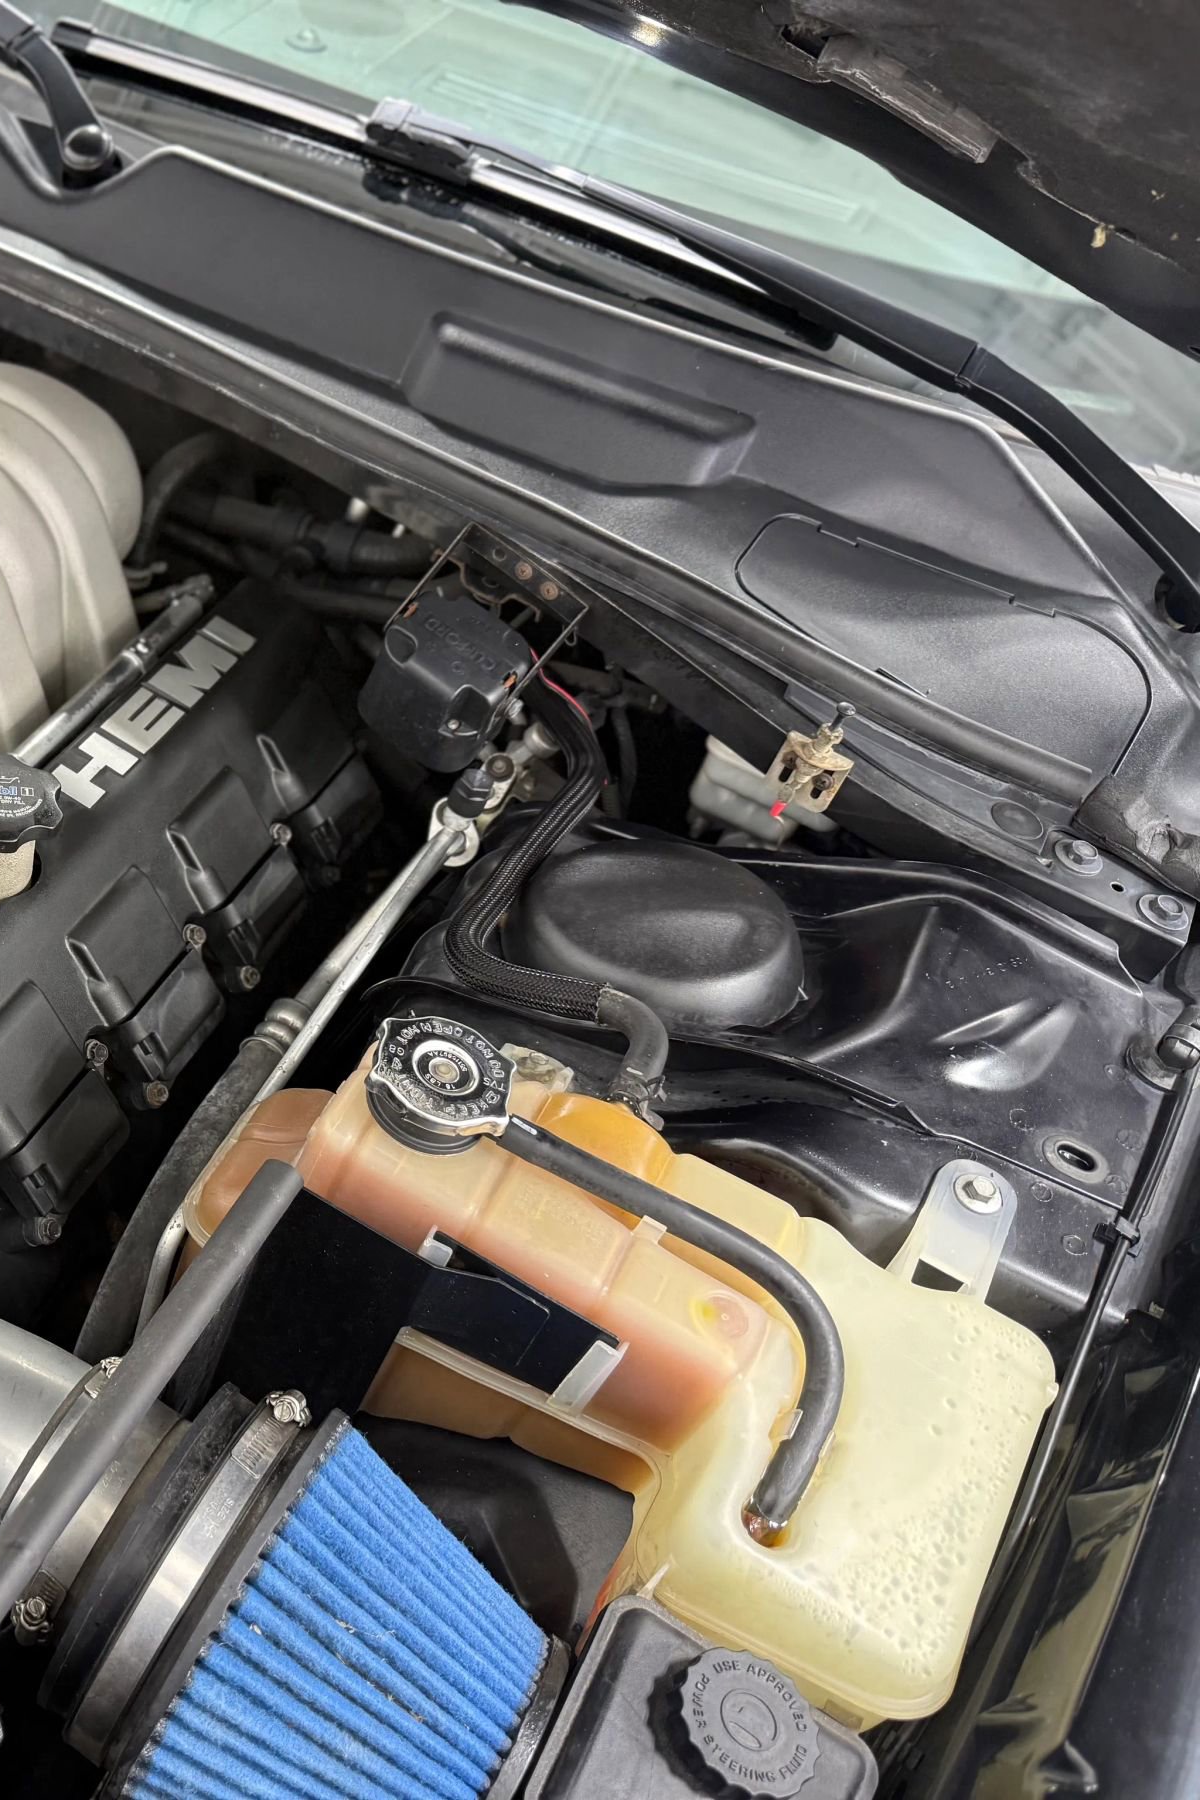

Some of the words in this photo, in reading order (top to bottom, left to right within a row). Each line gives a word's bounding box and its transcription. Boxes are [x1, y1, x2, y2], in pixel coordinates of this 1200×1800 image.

[51, 615, 256, 809] HEMI
[397, 1023, 421, 1045] HOT
[419, 1021, 464, 1036] OPEN
[465, 1034, 494, 1059] NOT
[424, 1072, 443, 1088] LBS
[488, 1059, 505, 1078] DO
[444, 1100, 489, 1116] KEEP
[712, 1660, 742, 1674] USE
[691, 1672, 711, 1729] POWER
[746, 1663, 808, 1732] APPROVED
[703, 1733, 776, 1783] STEERING
[778, 1743, 809, 1780] FLUID
